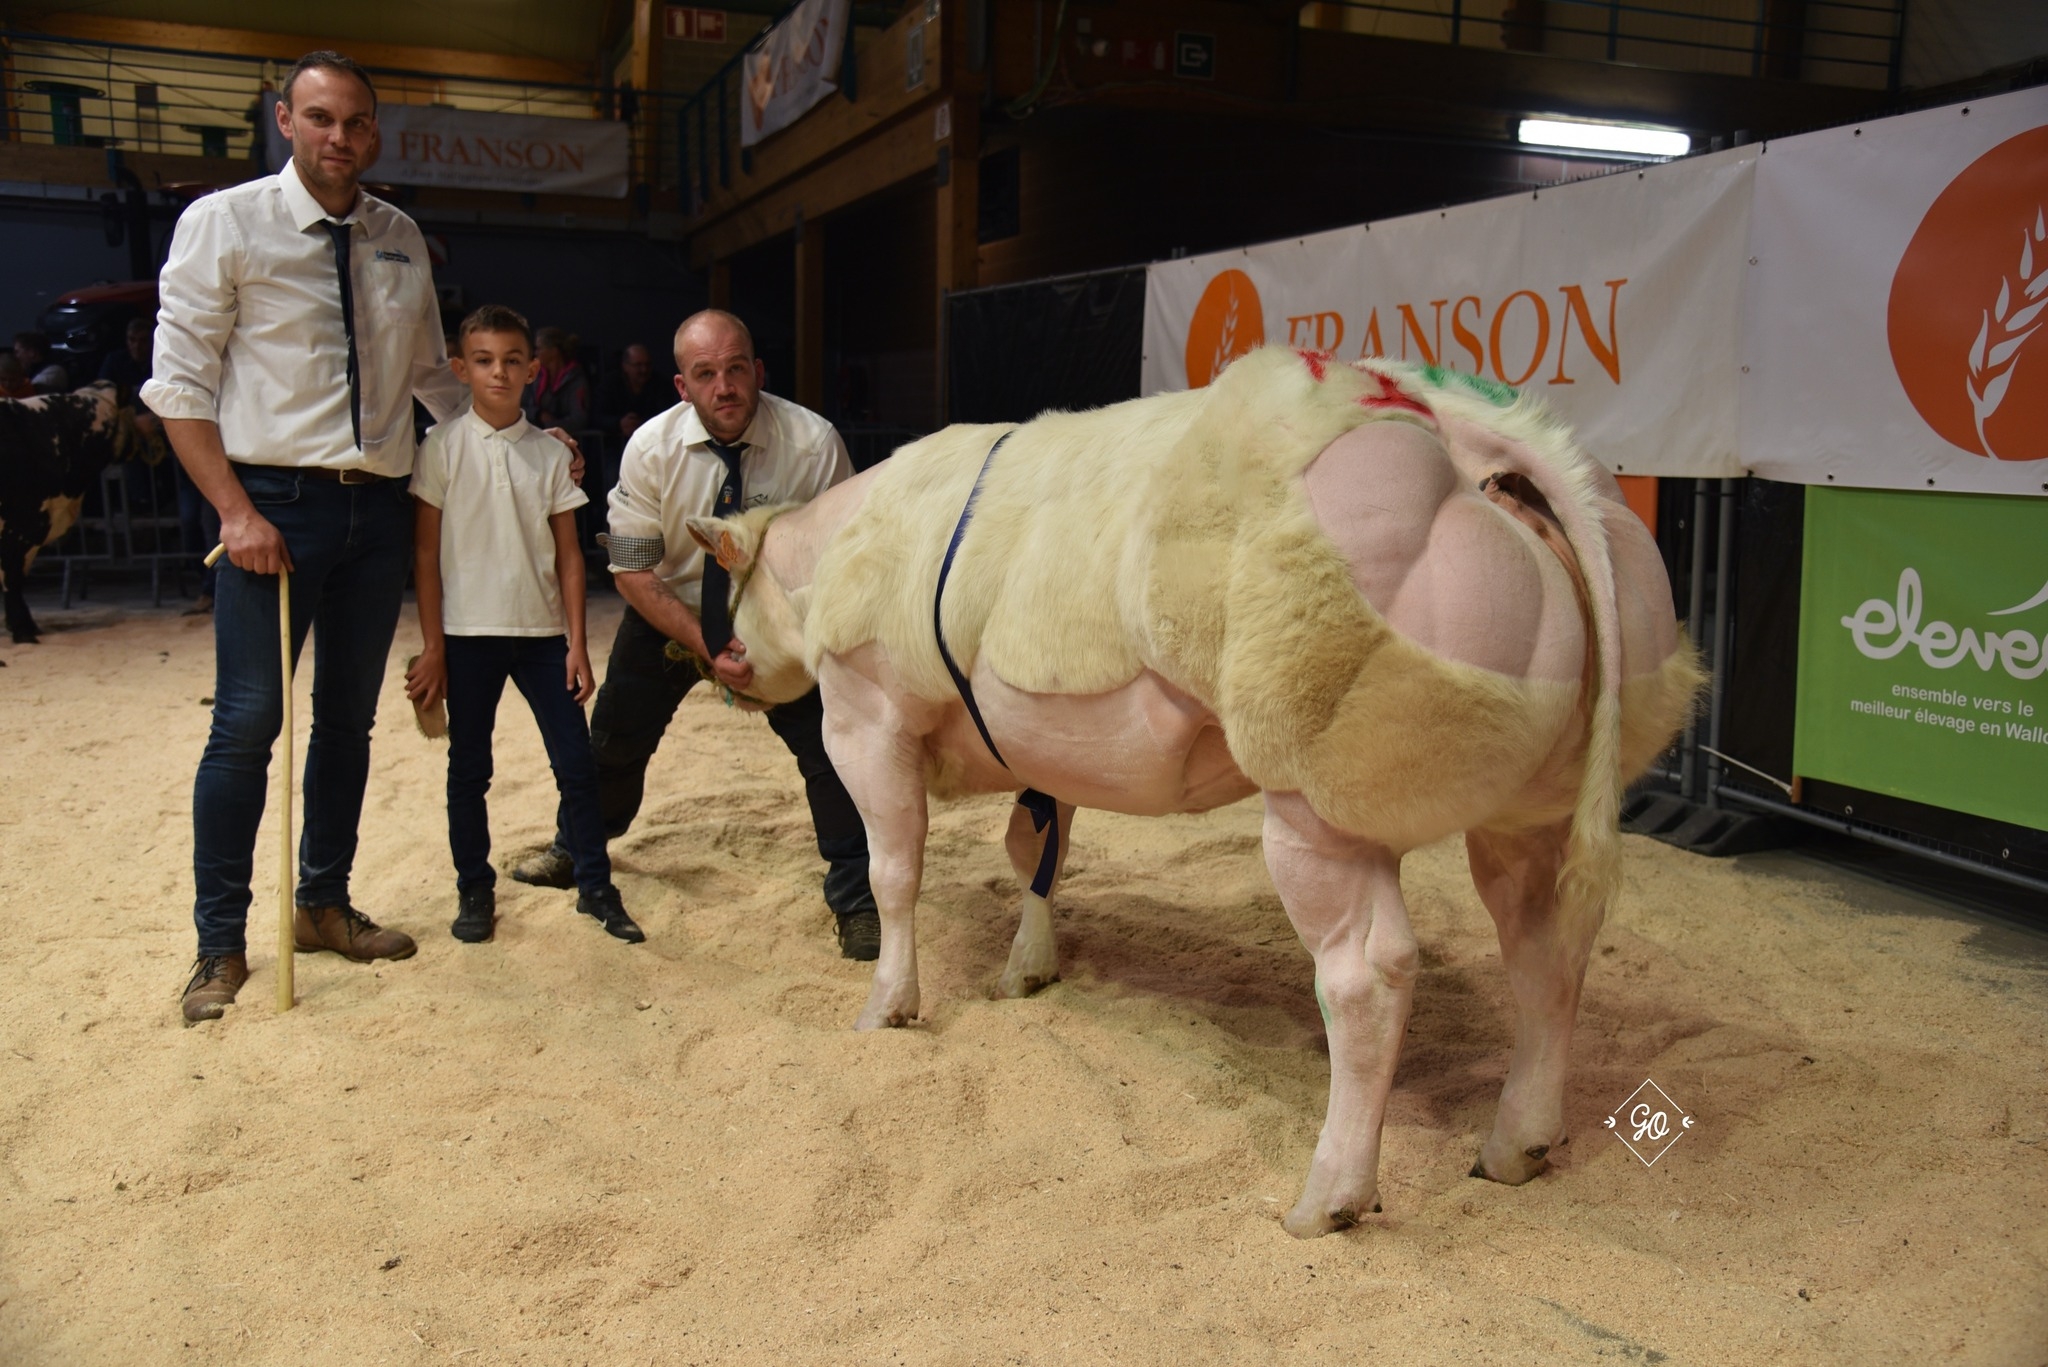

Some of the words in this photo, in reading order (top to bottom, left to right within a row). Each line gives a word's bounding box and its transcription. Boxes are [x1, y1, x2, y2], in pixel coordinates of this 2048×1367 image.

[398, 130, 585, 173] FRANSON
[1840, 567, 2048, 681] eleve
[1850, 699, 1911, 720] meilleur
[1914, 707, 1975, 734] élevage
[1979, 721, 2001, 736] en
[1891, 684, 1967, 707] ensemble
[1973, 696, 2012, 714] vers
[2018, 699, 2034, 717] le
